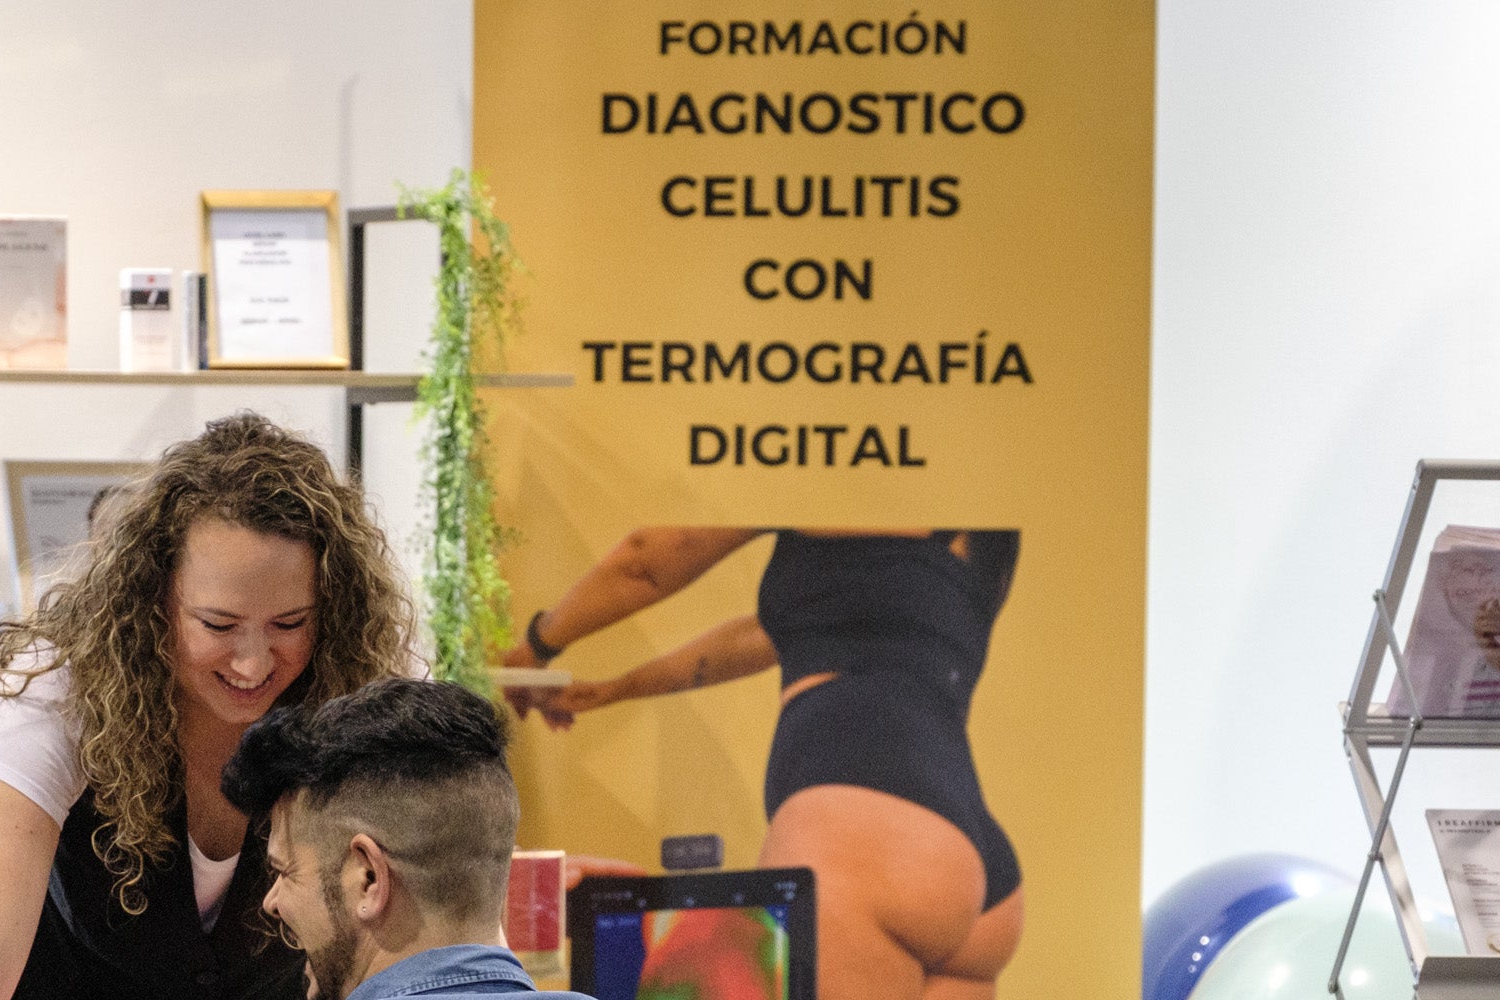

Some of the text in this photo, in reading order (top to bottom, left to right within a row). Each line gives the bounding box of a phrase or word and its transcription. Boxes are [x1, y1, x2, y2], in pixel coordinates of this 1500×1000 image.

[659, 10, 968, 56] FORMACIÓN
[600, 91, 1027, 135] DIAGNOSTICO
[660, 175, 962, 218] CELULITIS
[743, 258, 873, 301] CON
[583, 330, 1034, 385] TERMOGRAFÍA
[689, 425, 926, 468] DIGITAL
